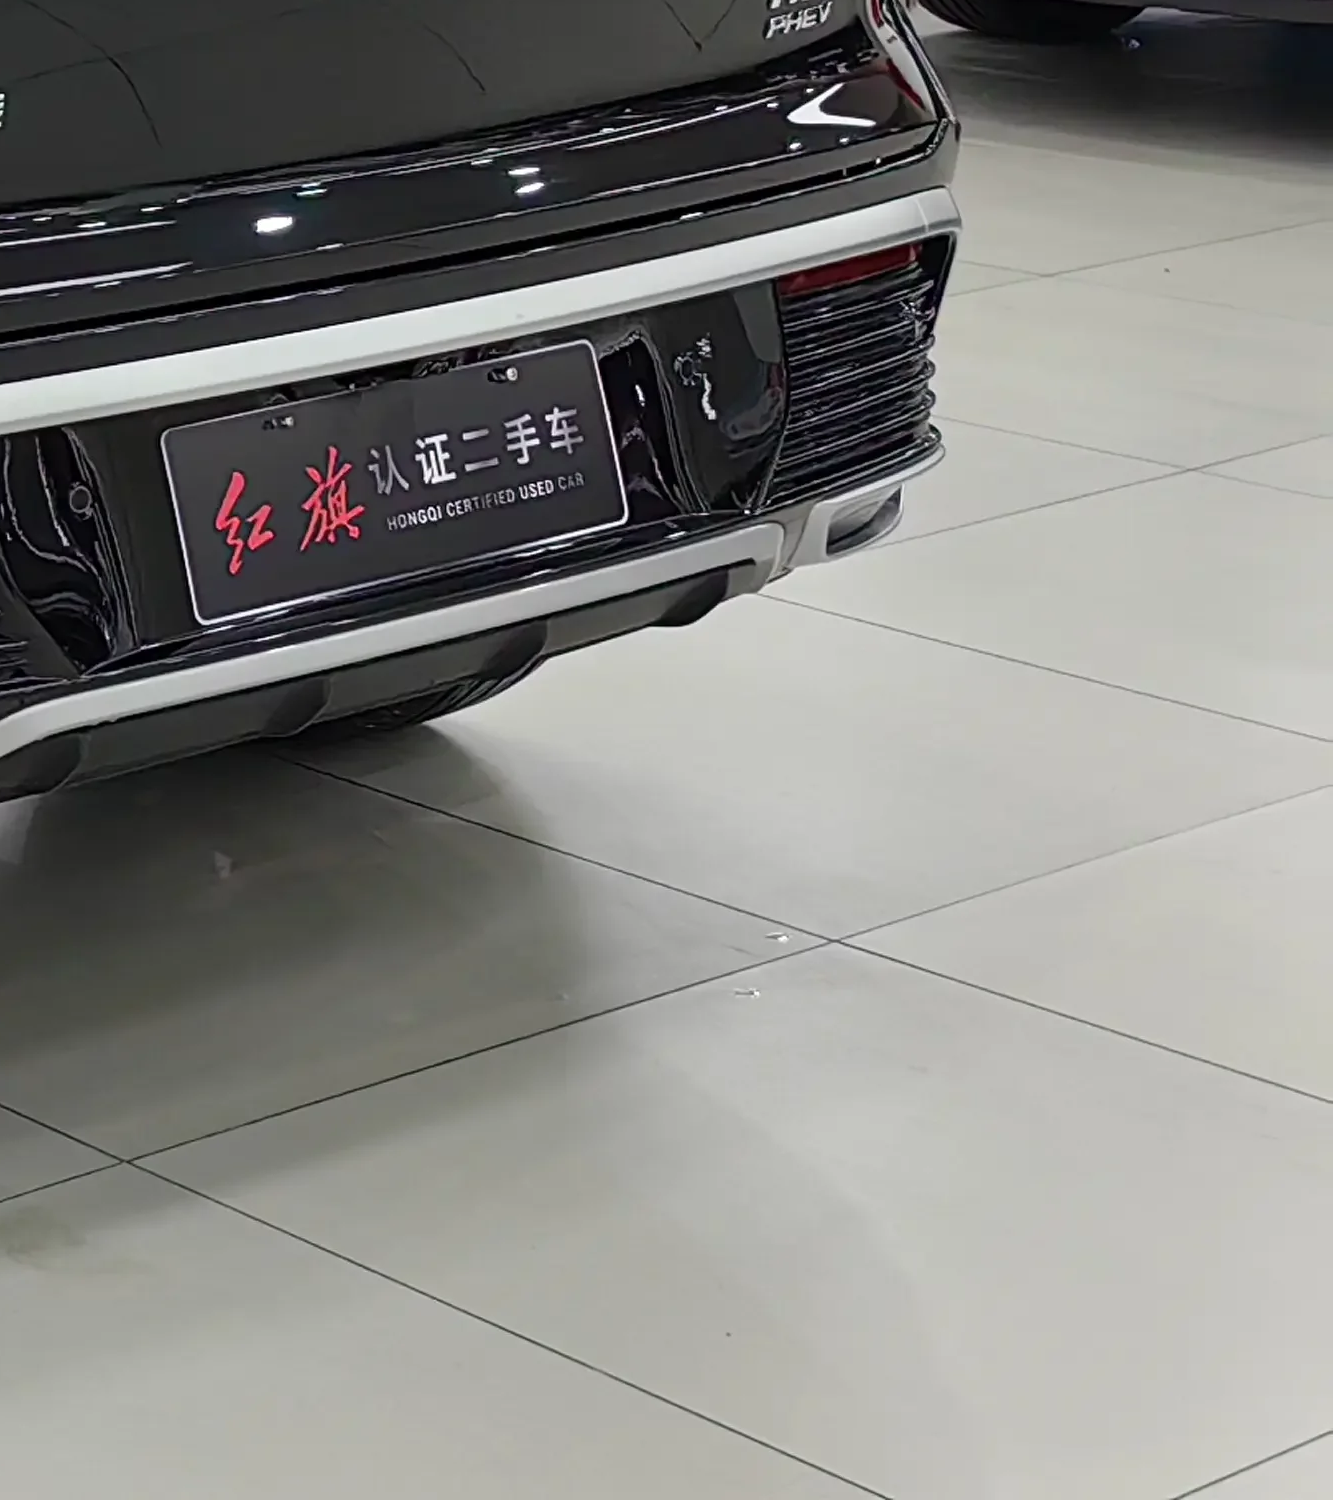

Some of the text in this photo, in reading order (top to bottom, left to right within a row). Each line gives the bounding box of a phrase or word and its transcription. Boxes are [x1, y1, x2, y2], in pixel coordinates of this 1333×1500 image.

[765, 1, 833, 39] PHEV
[214, 406, 585, 575] 红旗 认证二手车
[386, 472, 584, 531] HONGQI CERTIFIED USED CAR
